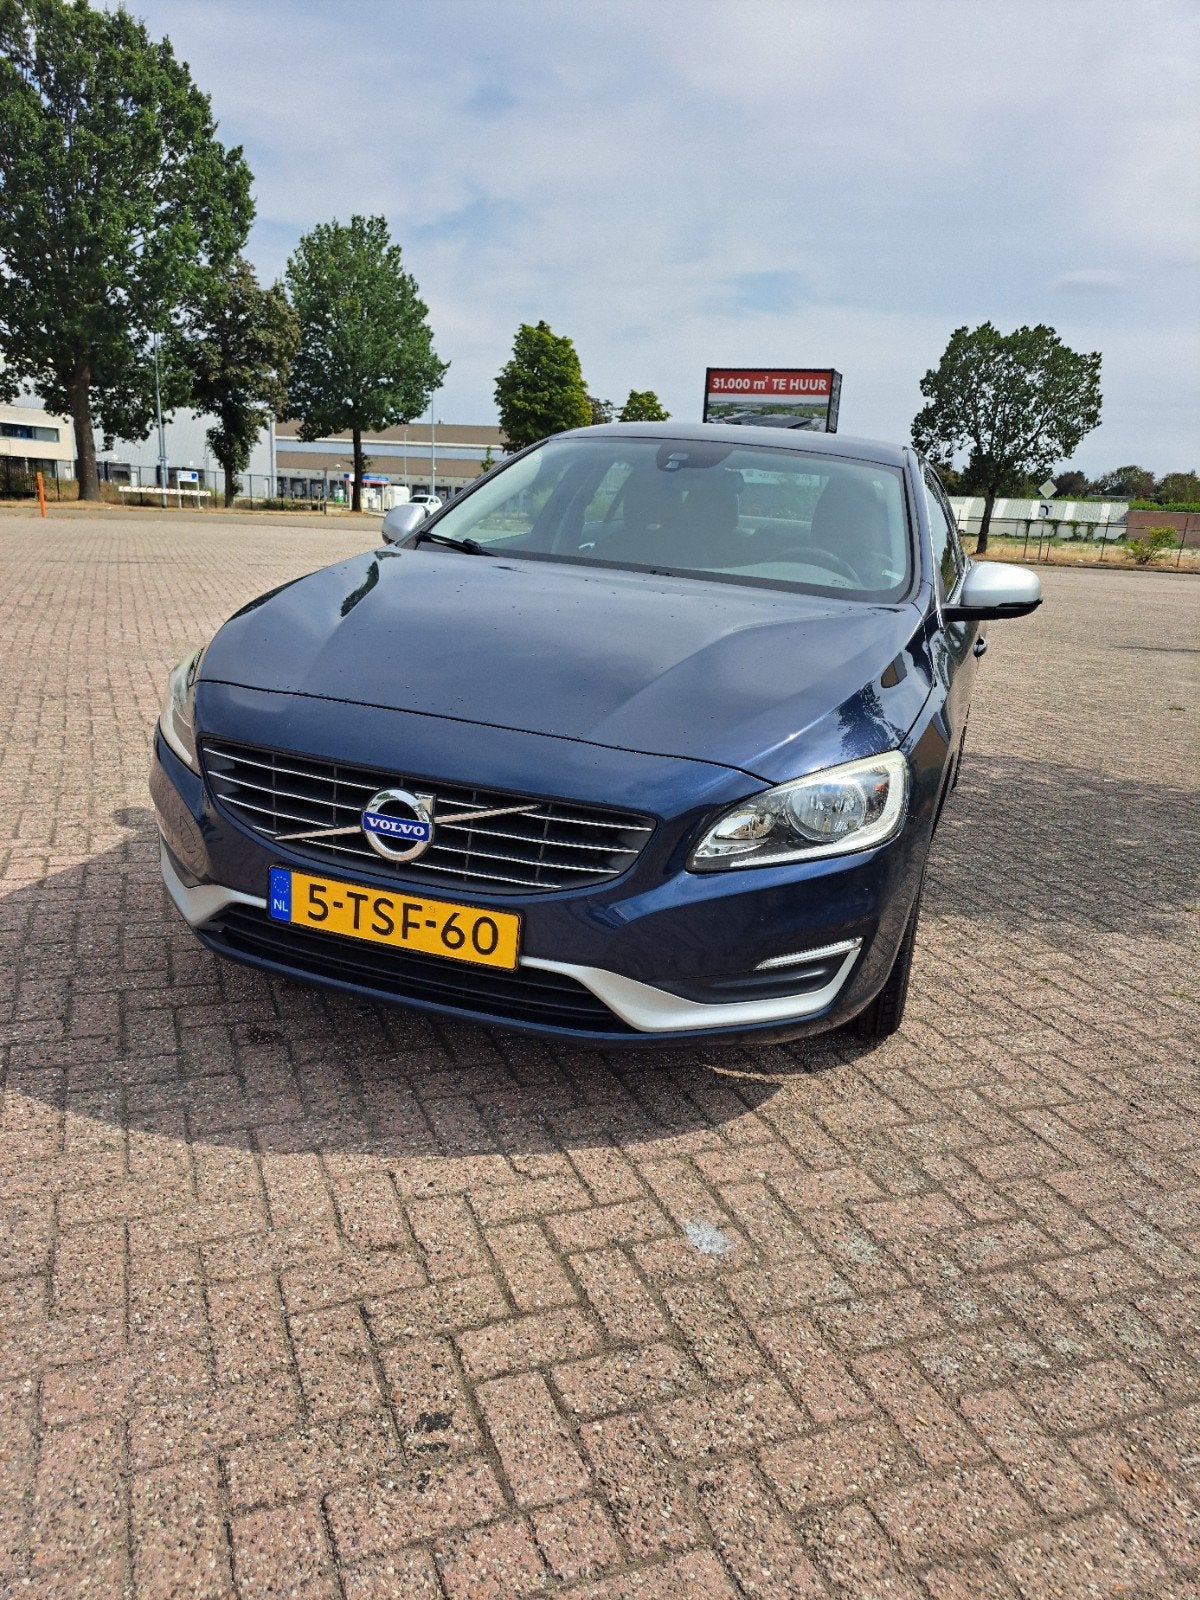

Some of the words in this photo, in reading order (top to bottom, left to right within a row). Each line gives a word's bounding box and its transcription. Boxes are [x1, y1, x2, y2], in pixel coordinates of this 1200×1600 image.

[713, 377, 750, 389] 31.000
[772, 378, 787, 390] TE
[789, 379, 827, 391] HUUR
[366, 816, 426, 836] VOLVO
[273, 899, 289, 912] NL
[307, 883, 499, 956] 5-TSF-60
